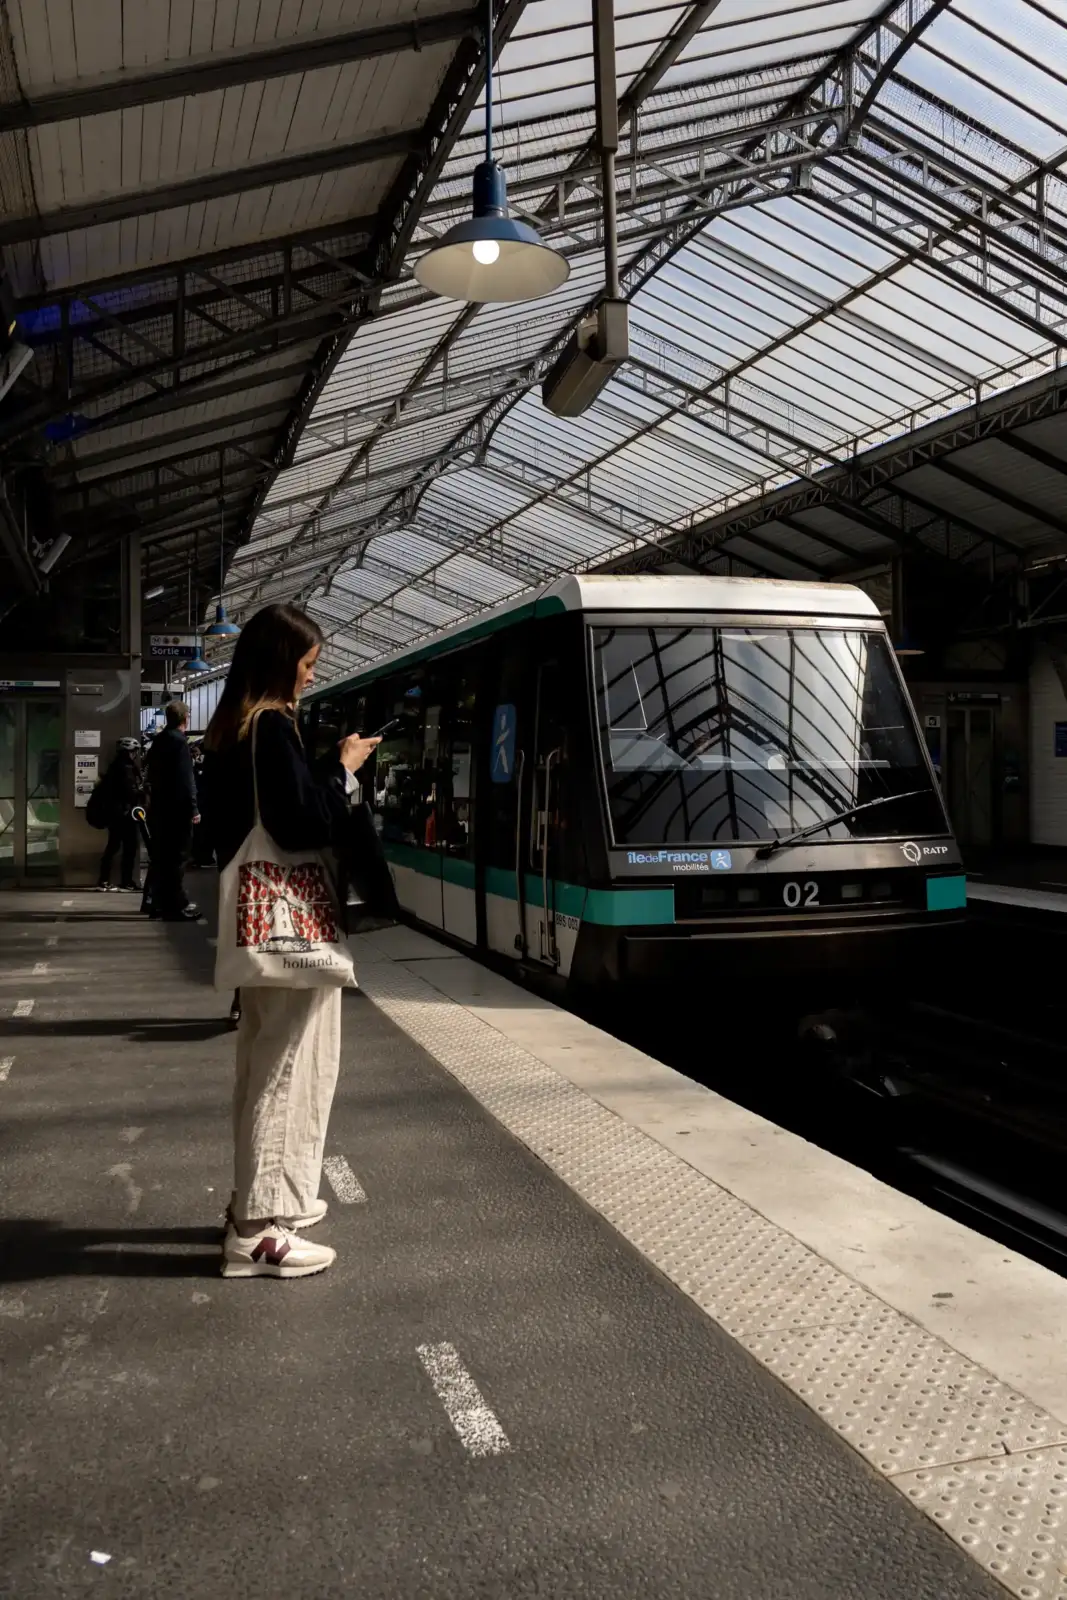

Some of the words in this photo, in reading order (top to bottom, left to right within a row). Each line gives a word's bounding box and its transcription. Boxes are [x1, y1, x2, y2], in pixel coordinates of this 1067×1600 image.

[152, 646, 180, 655] Sortie
[923, 846, 948, 855] RATP
[673, 863, 709, 871] mobilités
[782, 880, 820, 907] 02
